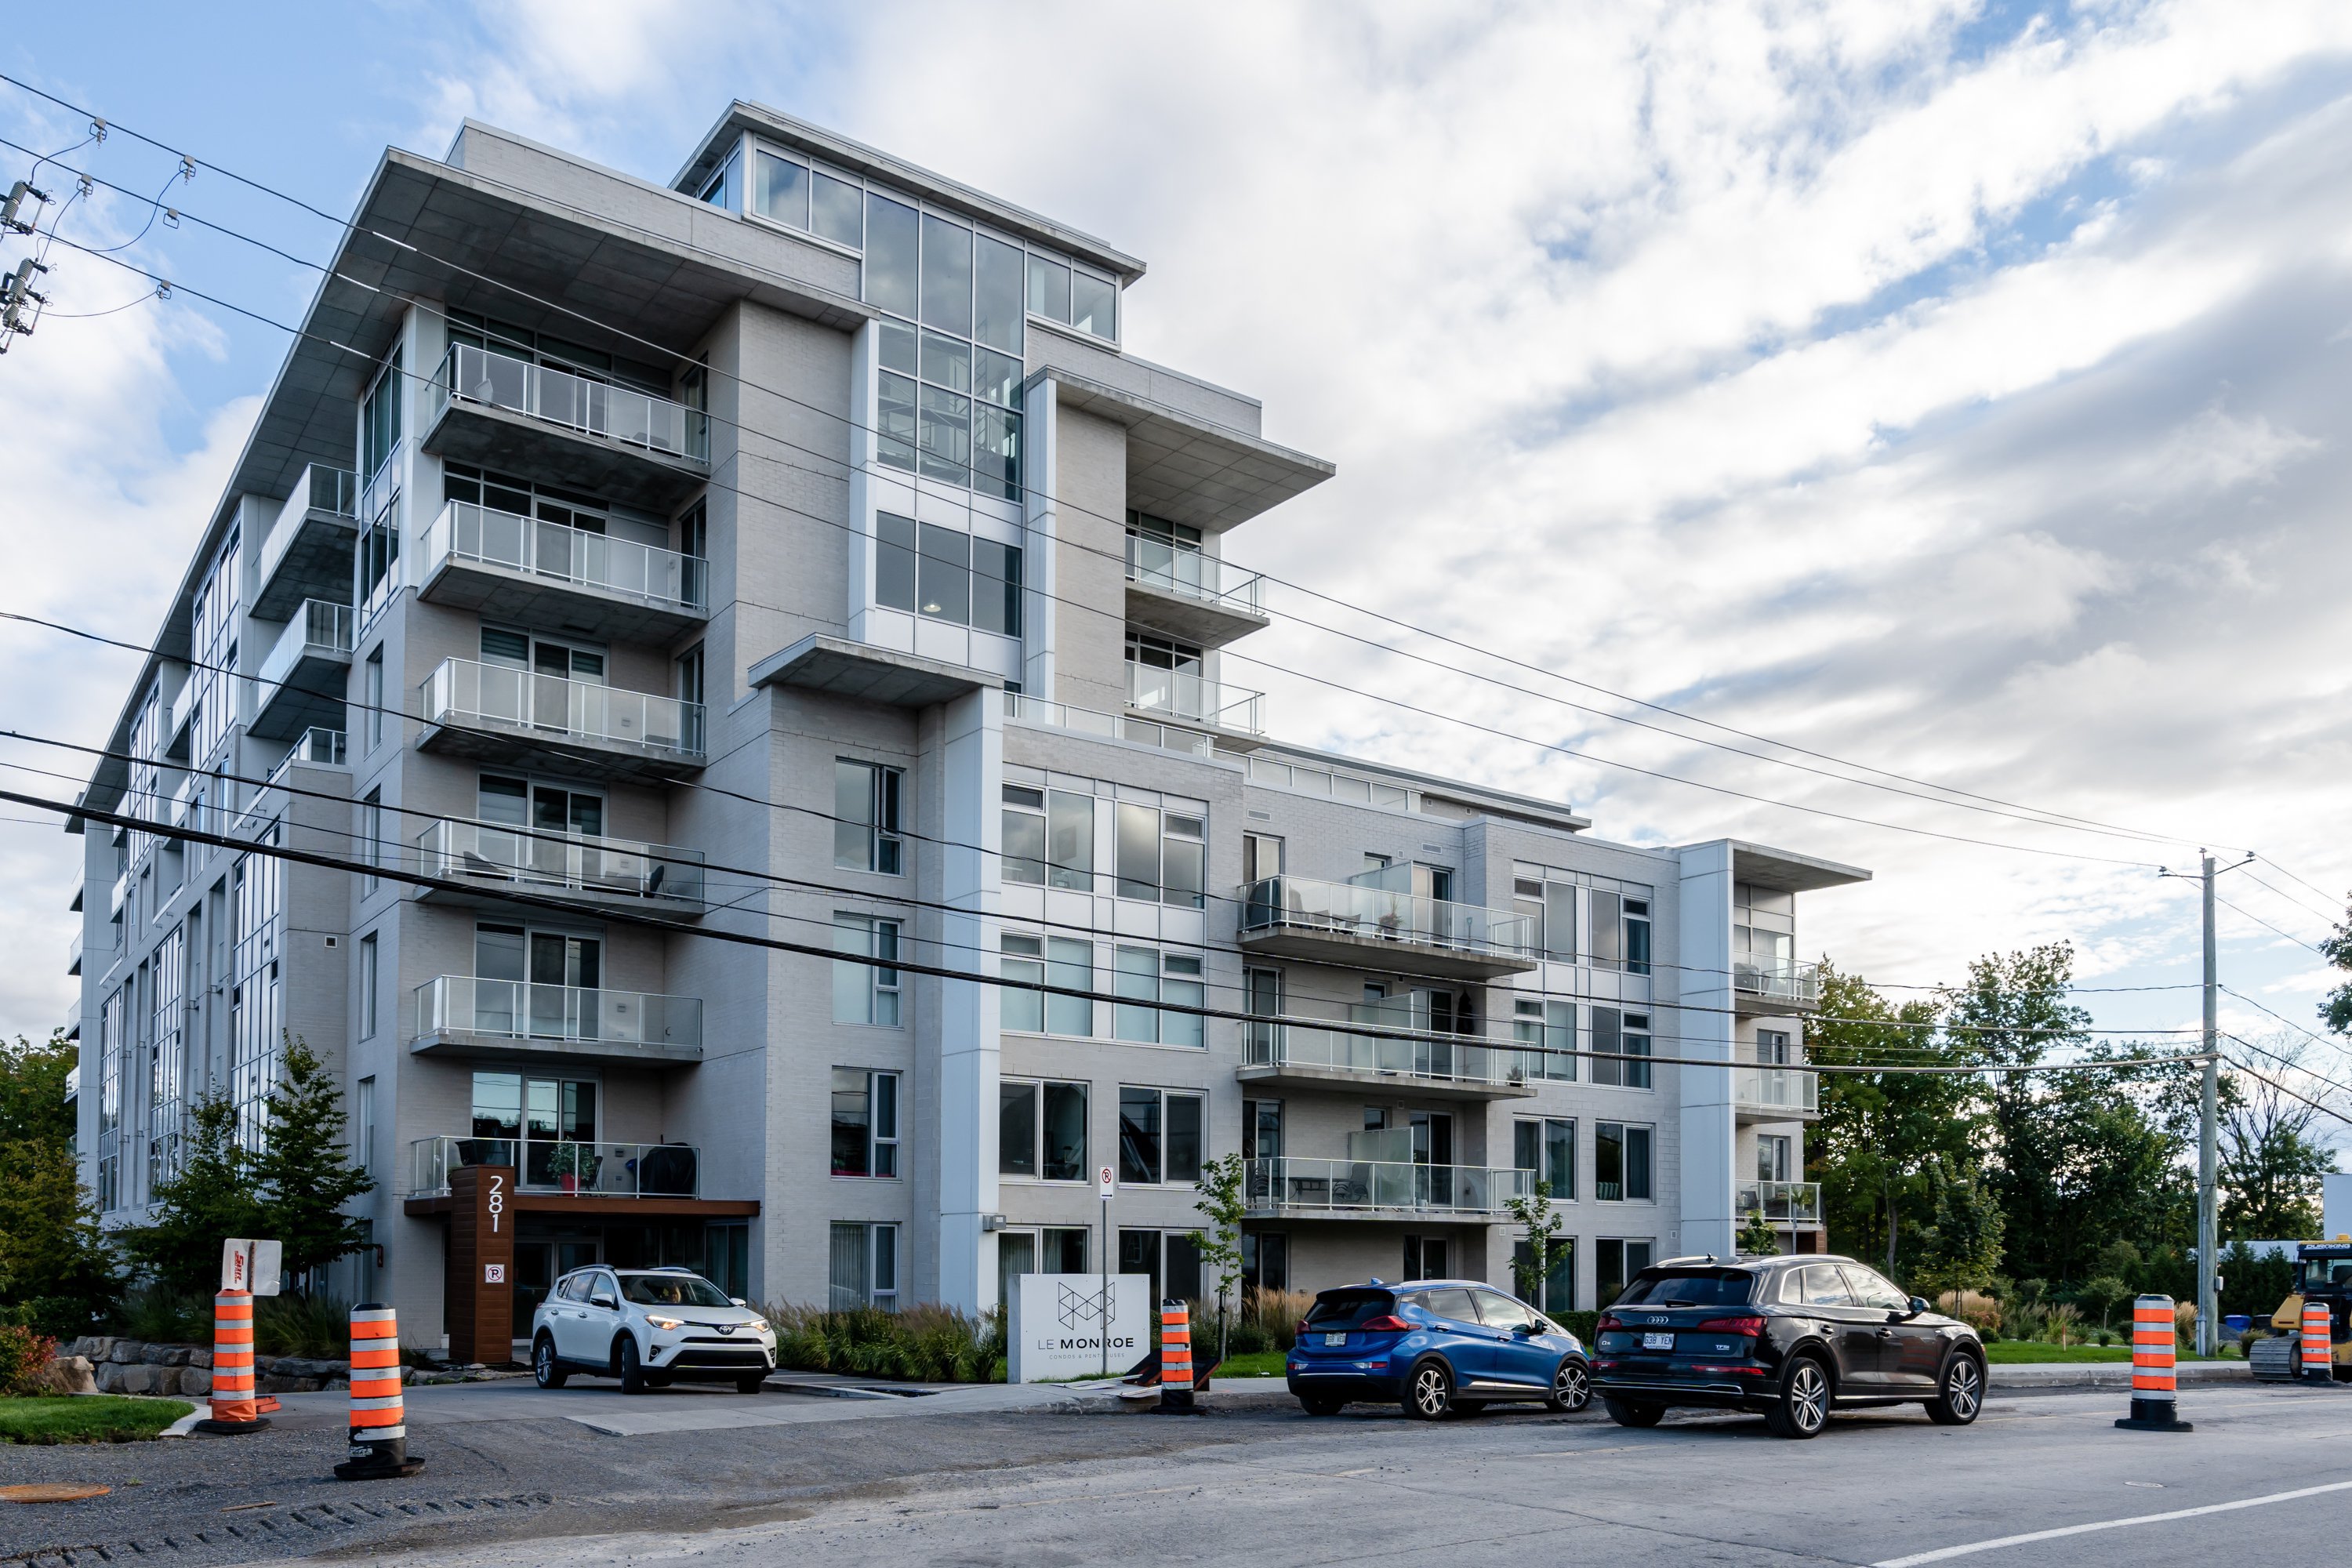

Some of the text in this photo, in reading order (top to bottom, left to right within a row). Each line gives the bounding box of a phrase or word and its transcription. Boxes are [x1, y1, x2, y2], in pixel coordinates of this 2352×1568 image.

[488, 1176, 503, 1232] 281
[1038, 1339, 1054, 1349] LE
[1661, 1336, 1673, 1345] YEN
